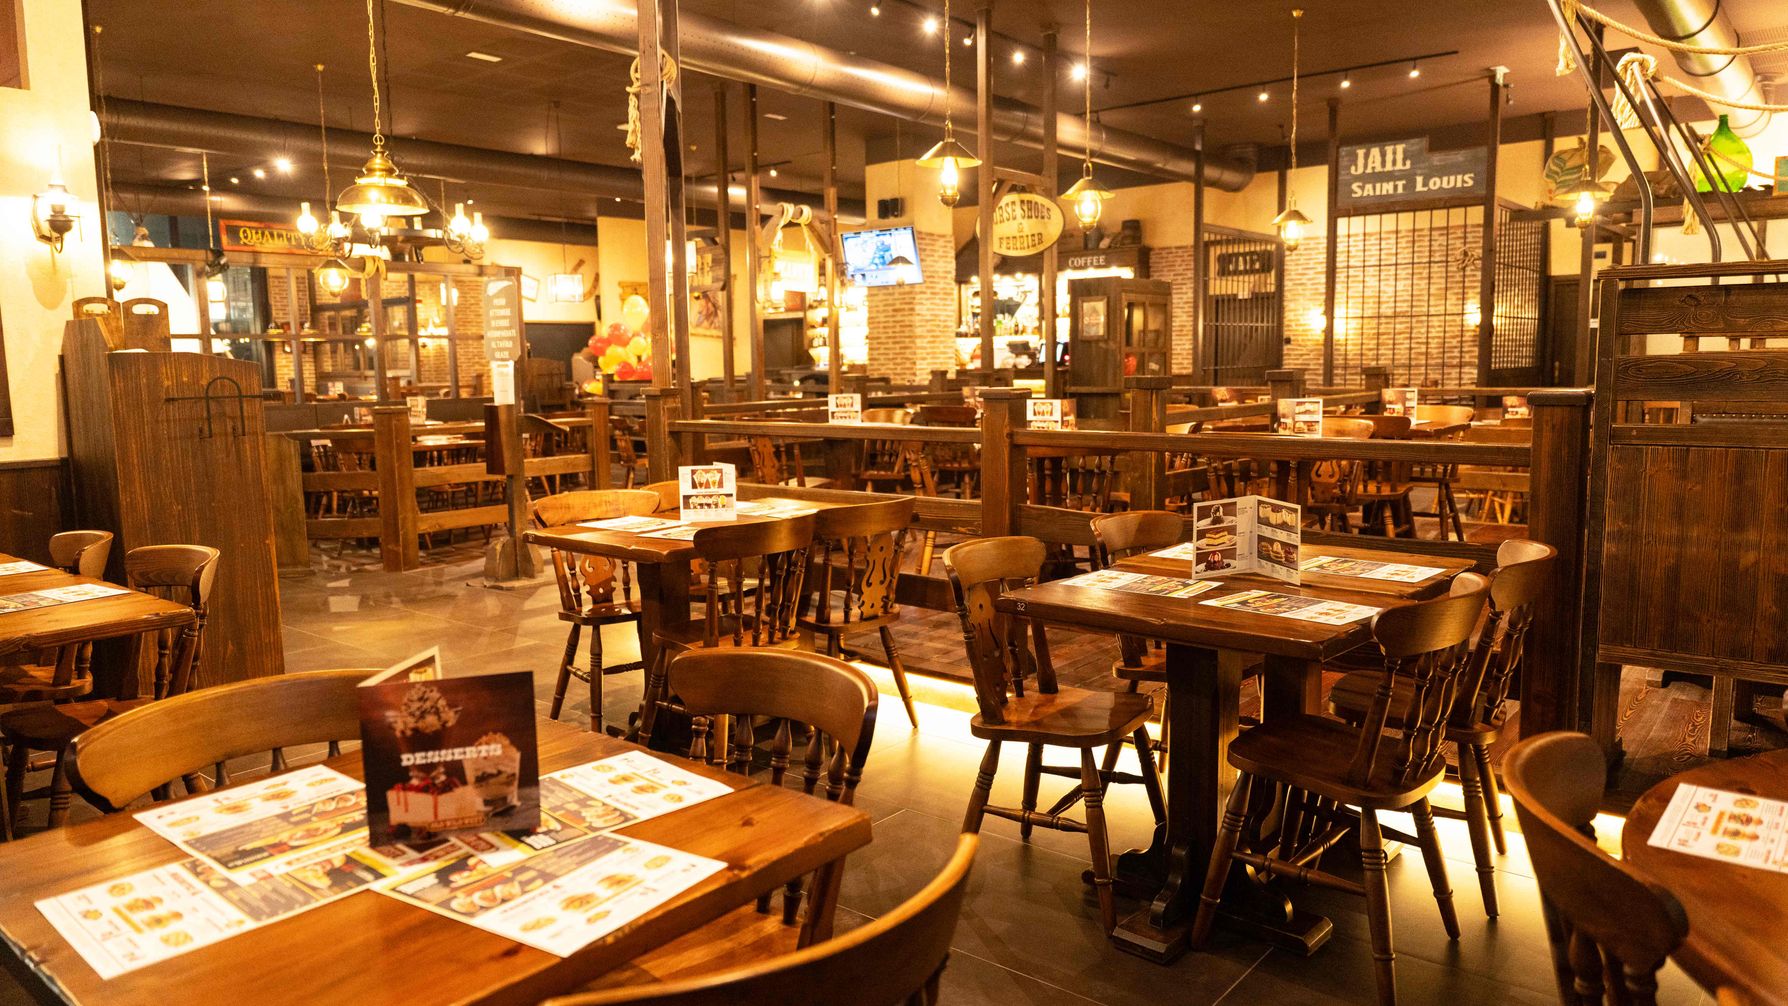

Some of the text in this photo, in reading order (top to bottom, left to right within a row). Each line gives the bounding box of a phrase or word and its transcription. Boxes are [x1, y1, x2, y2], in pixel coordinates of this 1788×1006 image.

[1350, 143, 1411, 175] JAIL
[1020, 199, 1052, 221] SHOES
[239, 227, 306, 246] QUALITY
[1016, 222, 1025, 233] &
[998, 232, 1044, 251] FERRIER
[1068, 255, 1106, 268] COFFEE
[400, 743, 503, 767] DESSERTS
